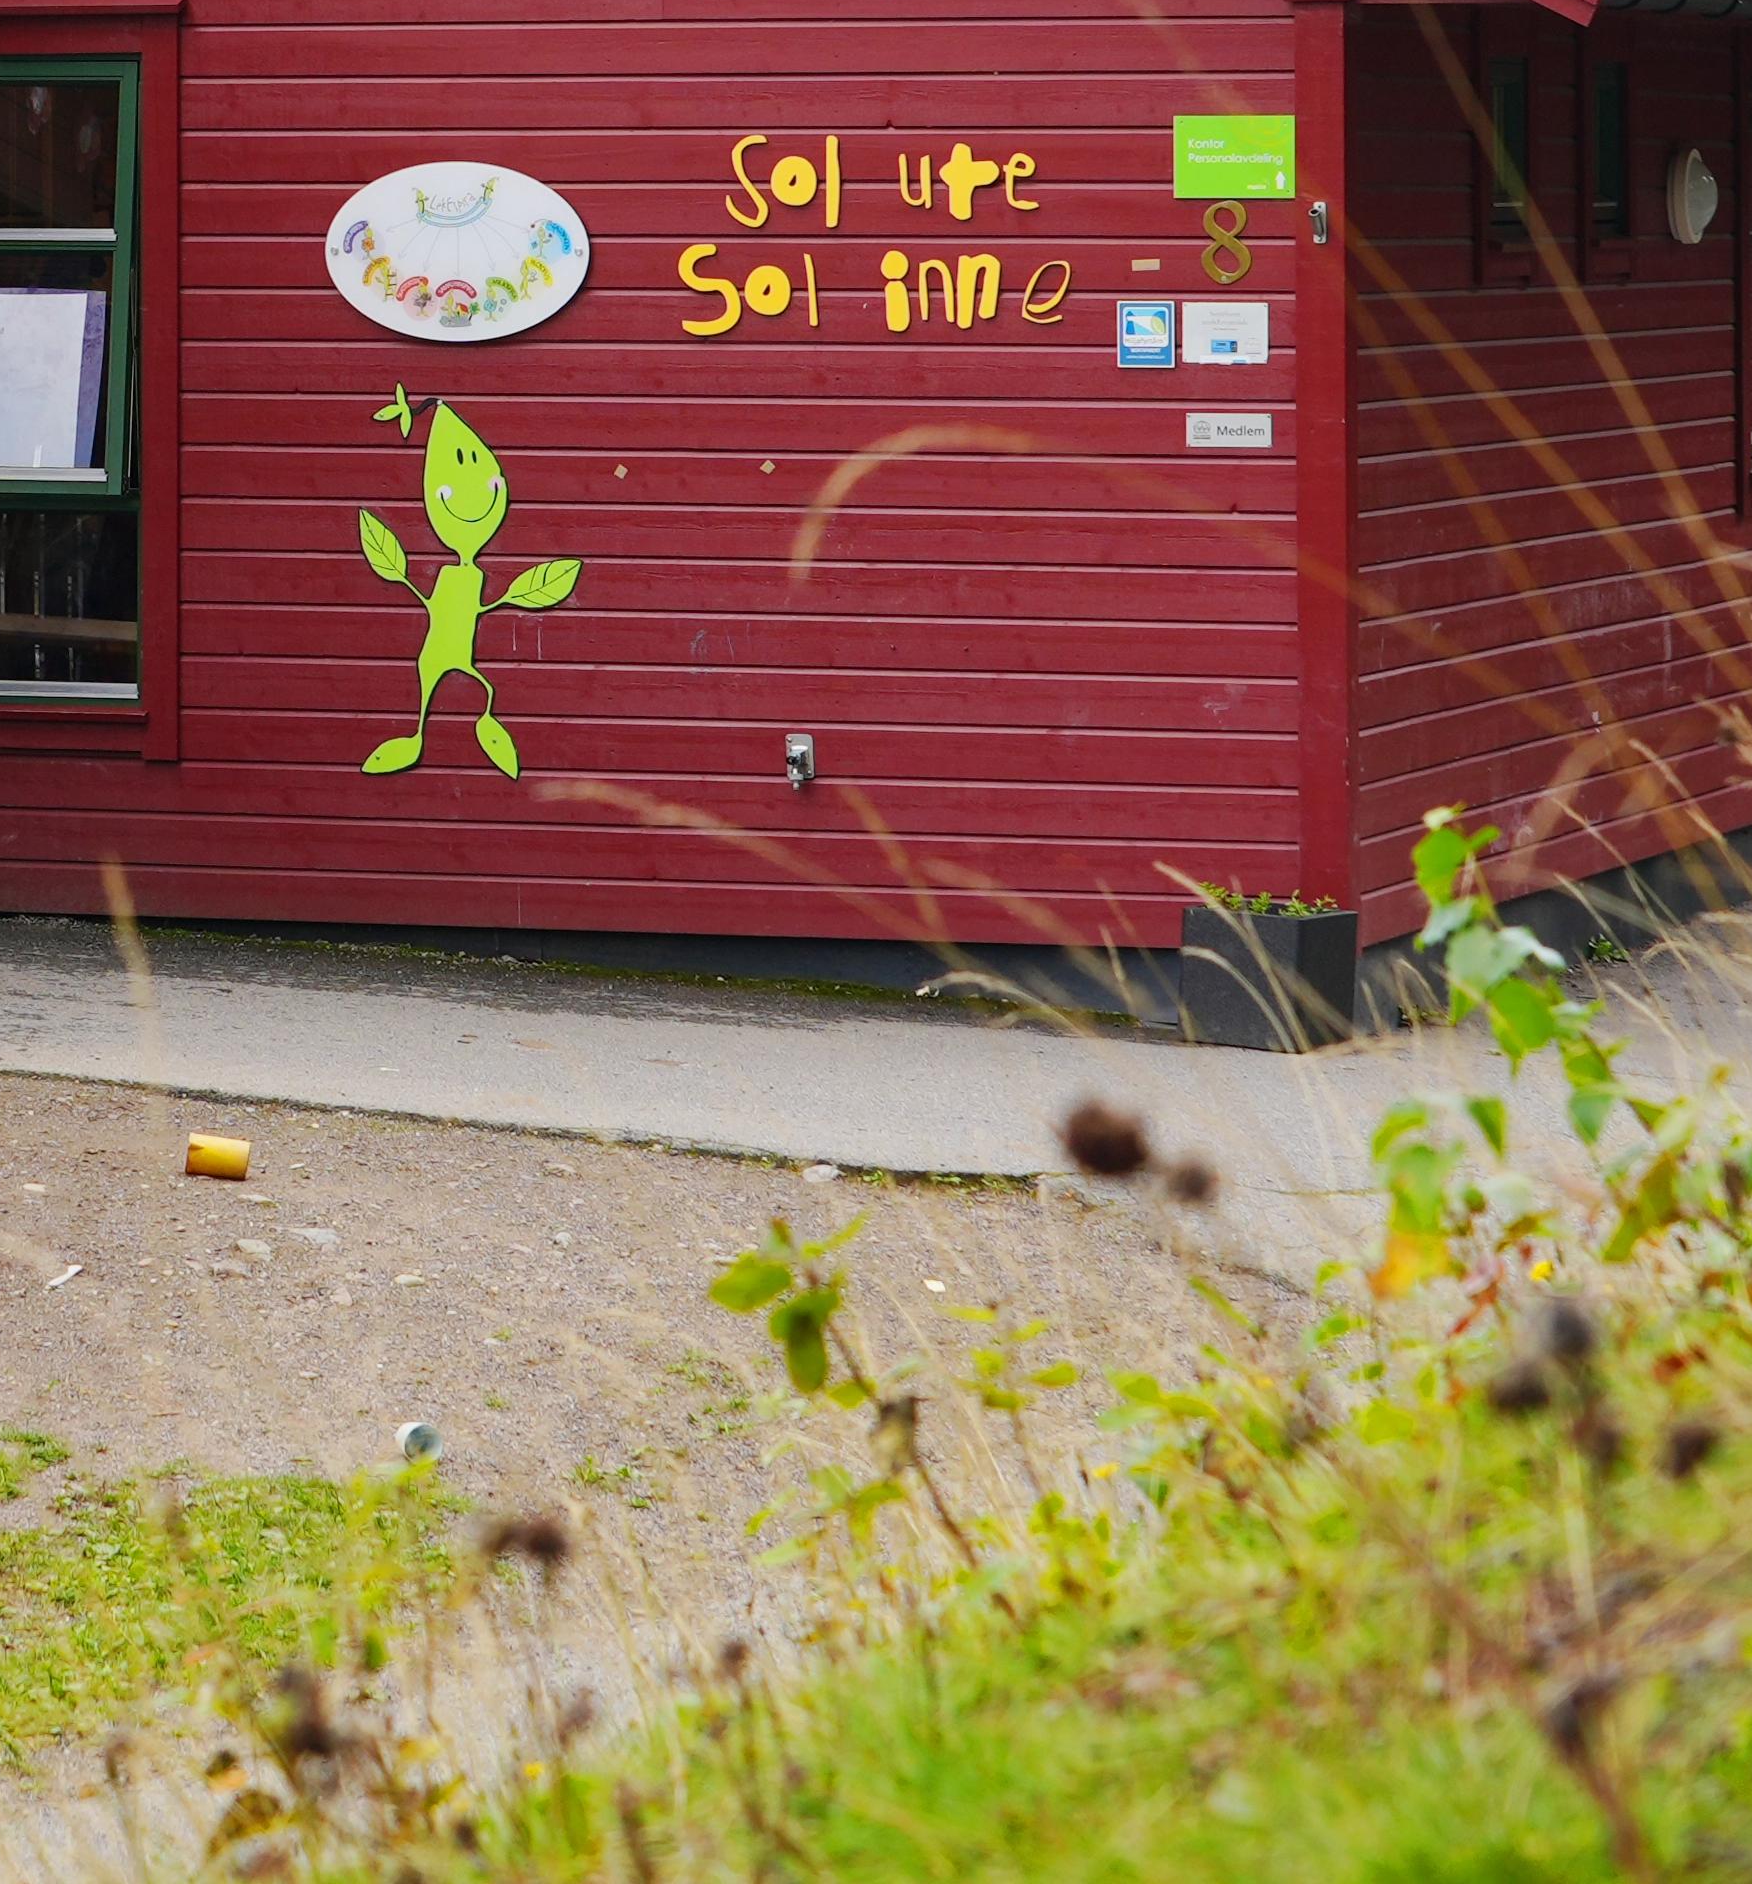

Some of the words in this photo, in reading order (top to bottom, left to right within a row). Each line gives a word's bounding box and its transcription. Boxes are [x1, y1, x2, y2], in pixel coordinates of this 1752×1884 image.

[1188, 138, 1225, 149] Kontor
[1188, 152, 1284, 166] Personalavdeling
[725, 134, 840, 228] Sol
[898, 142, 1039, 221] ute
[1202, 199, 1252, 285] 8
[677, 243, 819, 336] Sol
[1216, 425, 1265, 437] Medlem
